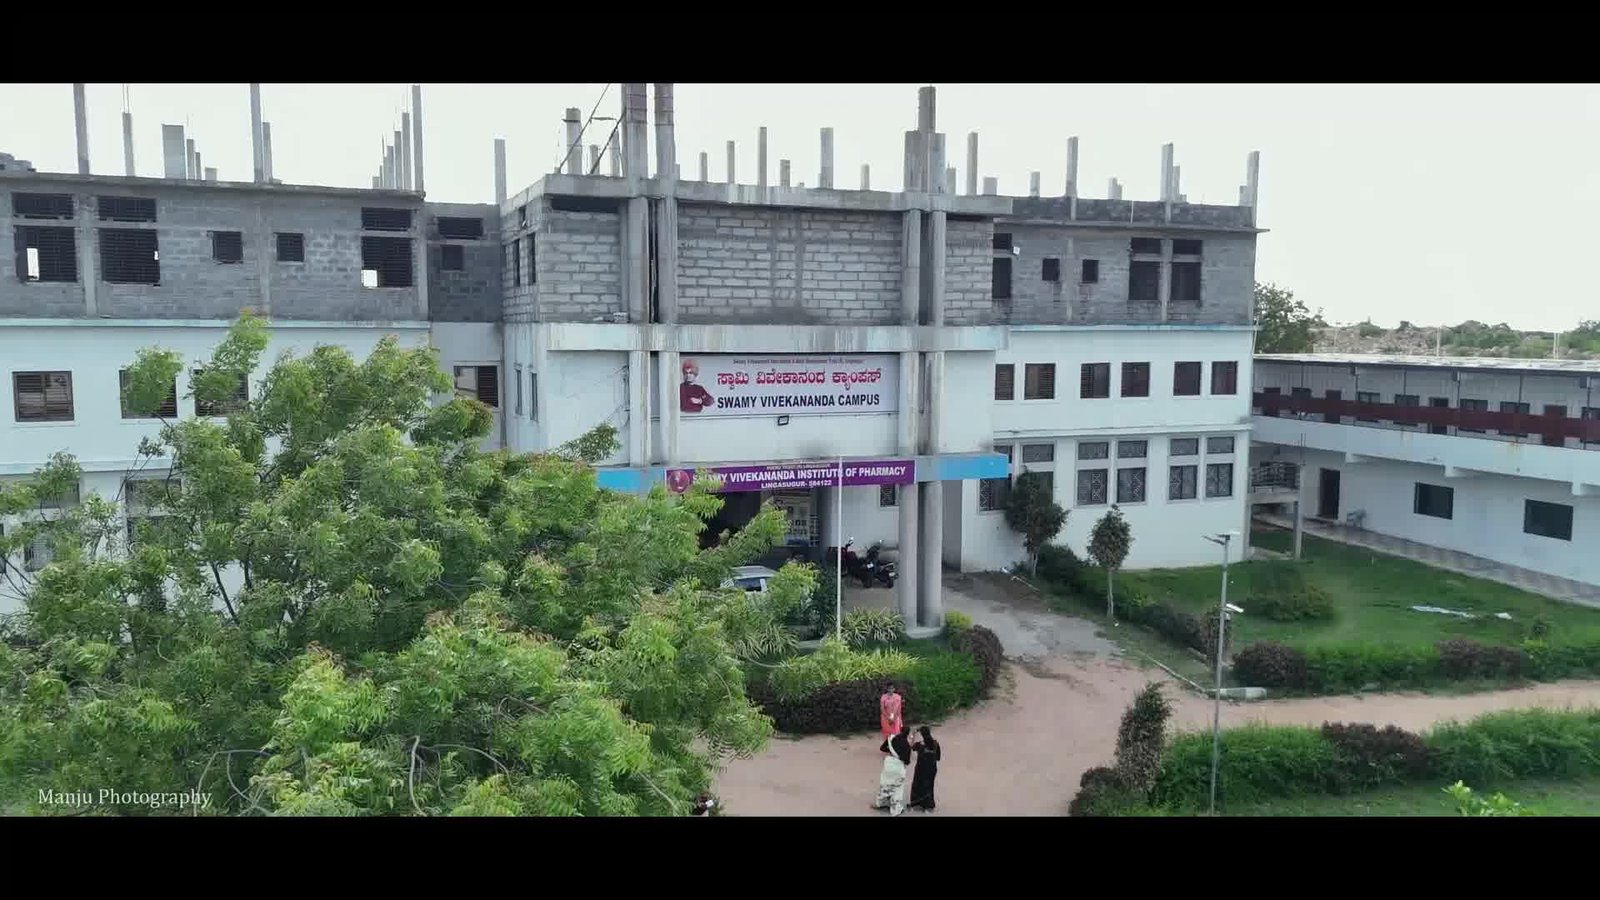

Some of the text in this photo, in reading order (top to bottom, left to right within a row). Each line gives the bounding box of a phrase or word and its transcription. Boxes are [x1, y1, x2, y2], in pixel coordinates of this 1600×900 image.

[717, 367, 882, 391] ಸ್ವಾಮಿ ವಿವೇಕಾನಂದ ಕ್ಯಾಂಪಸ್
[717, 393, 881, 409] SWAMY VIVEKANANDA CAMPUS
[730, 470, 795, 482] VIVEKANANDA
[845, 467, 857, 477] OF
[859, 466, 906, 477] PHARMACY
